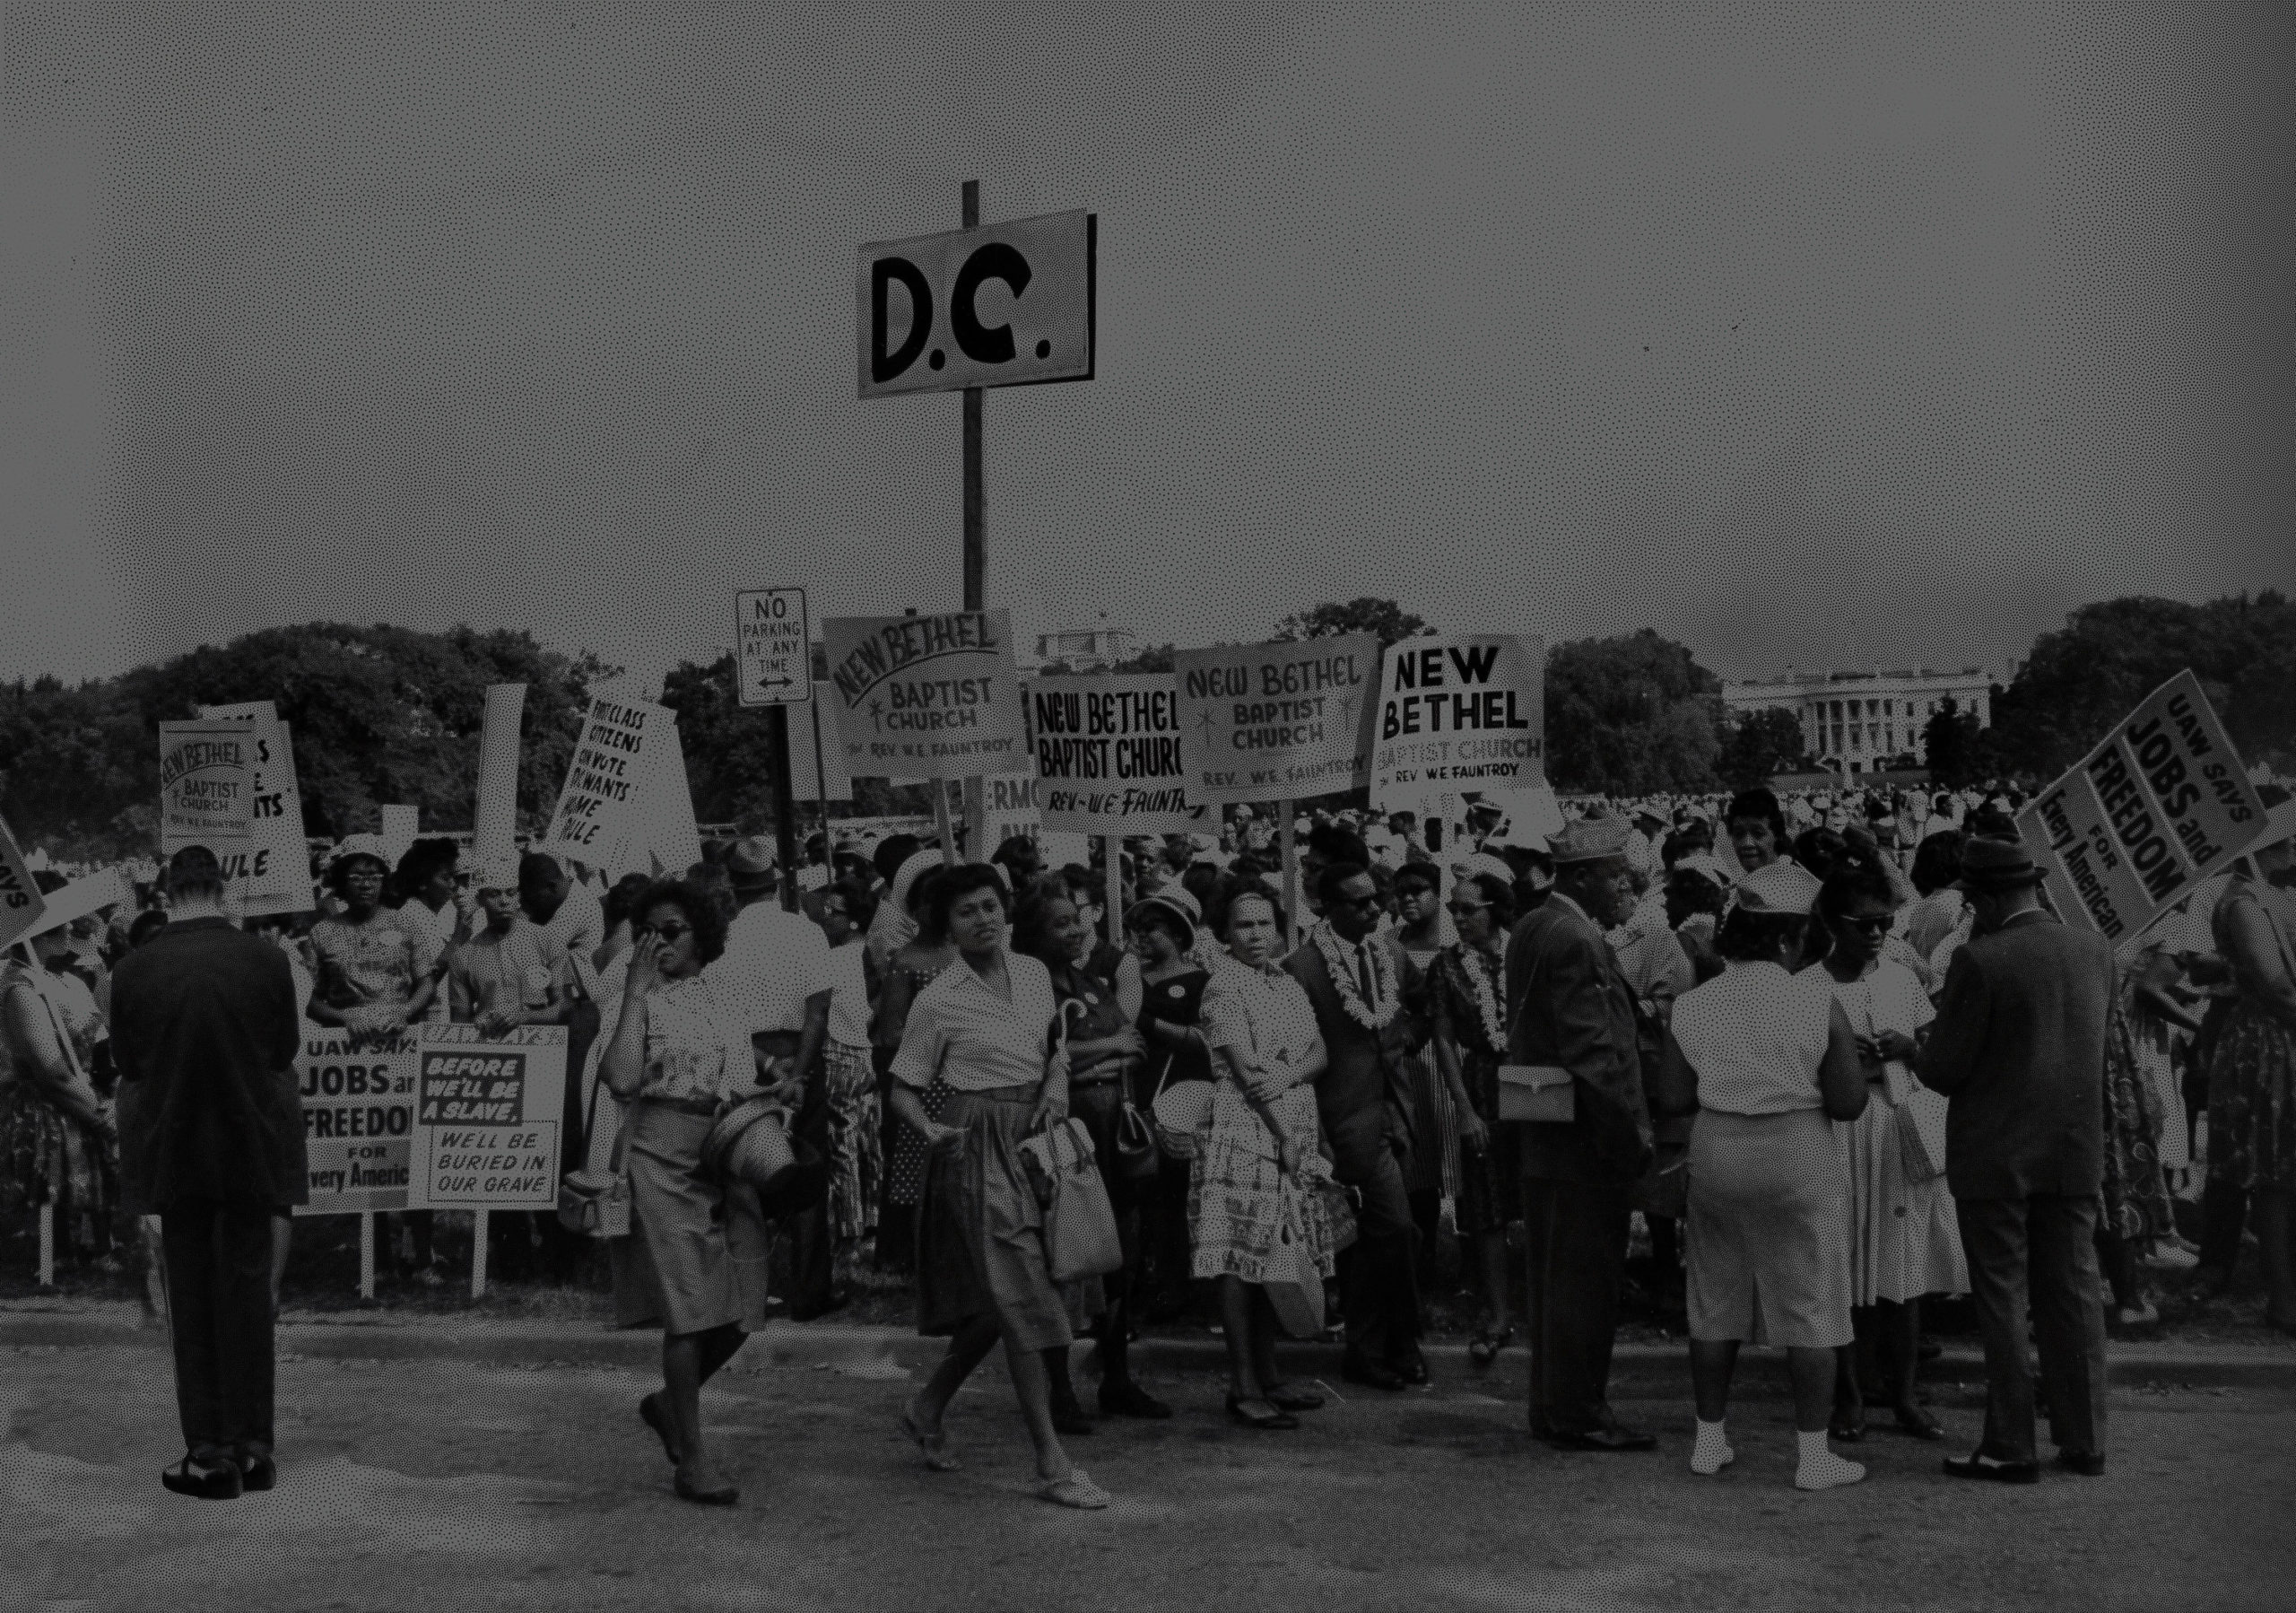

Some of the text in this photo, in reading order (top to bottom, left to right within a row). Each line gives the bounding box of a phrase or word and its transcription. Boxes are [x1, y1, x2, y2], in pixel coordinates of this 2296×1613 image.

[872, 257, 1051, 383] D.C.
[755, 597, 787, 619] NO
[743, 621, 801, 638] PARKING
[747, 639, 799, 656] AT ANY
[833, 614, 1000, 708] NEW BETHEL
[759, 658, 789, 673] TIME
[1187, 654, 1362, 700] NEW BETHEL
[1395, 645, 1500, 693] NEW
[890, 676, 992, 709] BAPTIST
[609, 704, 648, 730] CLASS
[886, 708, 978, 731] CHURCH
[1036, 691, 1082, 735] NEW
[1087, 690, 1180, 736] BETHEL
[1232, 696, 1326, 726] BAPTIST
[1383, 690, 1529, 741] BETHEL
[931, 737, 1014, 758] FAUNTROY
[1232, 721, 1324, 750] CHURCH
[183, 741, 245, 771] BETHEL
[591, 751, 627, 778] VOTE
[1038, 736, 1184, 780] BAPTIST CHURC
[1285, 754, 1367, 782] FAUNTROY
[1378, 737, 1542, 772] BAPTIST CHURCH
[2167, 692, 2254, 824] UAW SAYS
[1452, 762, 1520, 780] FAUNTROY
[184, 778, 239, 799] BAPTIST
[582, 771, 631, 803] WANTS
[2126, 717, 2223, 868] JOBS and
[180, 796, 230, 812] CHURCH
[2087, 743, 2187, 903] FREEDOM
[2088, 823, 2119, 871] FOR
[220, 849, 270, 882] ULE
[2039, 789, 2125, 941] Every American
[307, 1040, 361, 1057] UAW
[300, 1064, 390, 1097] JOBS
[426, 1057, 518, 1077] BEFORE
[426, 1077, 521, 1099] WE'LL BE
[301, 1104, 414, 1138] FREEDO
[422, 1100, 518, 1122] A SLAVE,
[347, 1147, 387, 1159] FOR
[439, 1129, 539, 1149] WE'LL BE
[437, 1153, 547, 1171] BURIED IN
[309, 1161, 410, 1194] very Americ
[437, 1174, 547, 1193] OUR GRAVE
